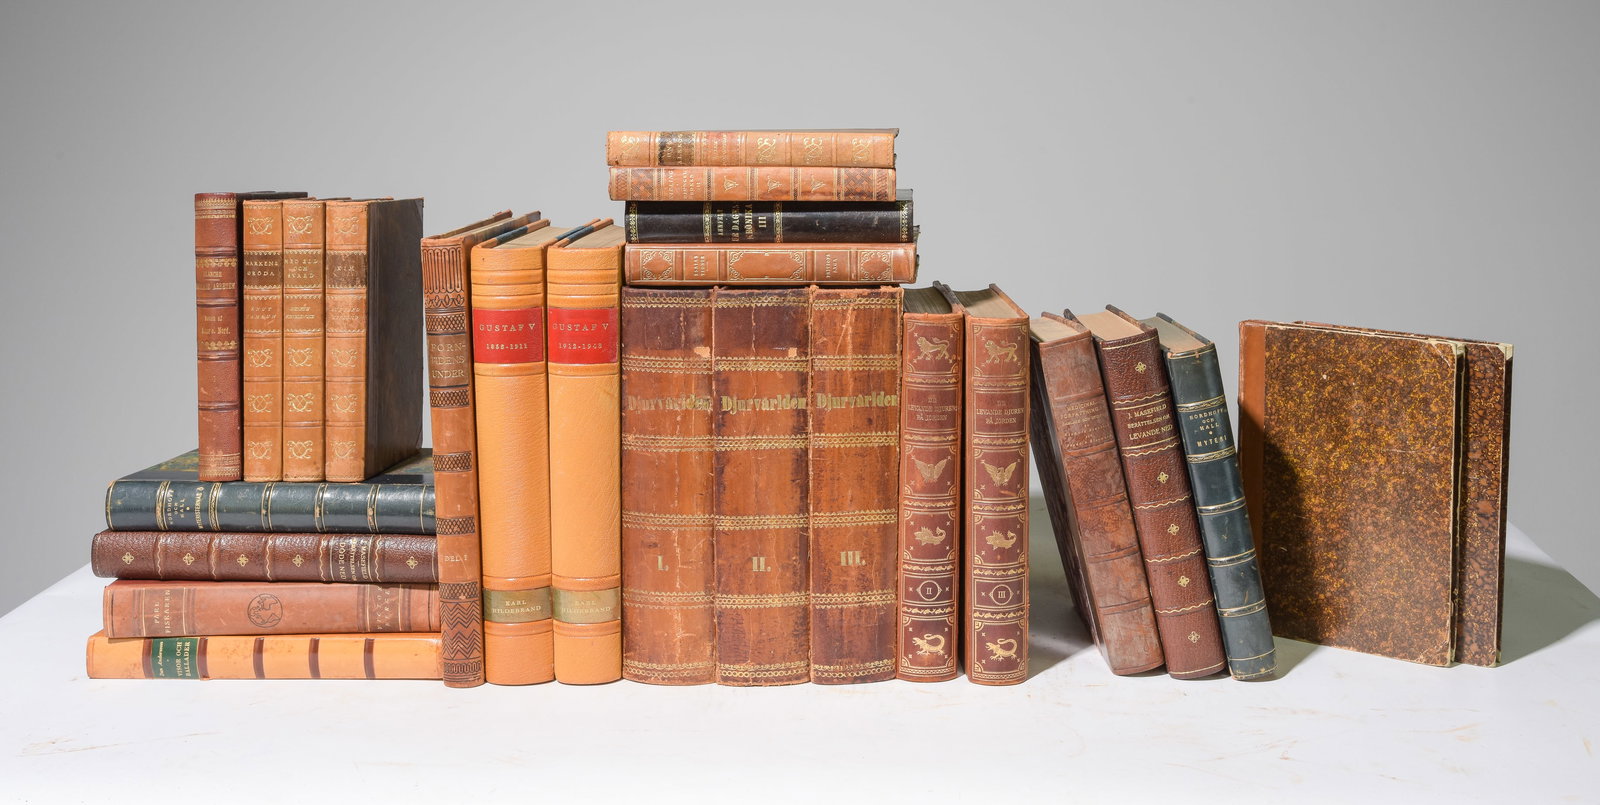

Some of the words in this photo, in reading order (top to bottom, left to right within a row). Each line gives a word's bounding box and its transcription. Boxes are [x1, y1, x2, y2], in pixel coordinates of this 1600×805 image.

[758, 215, 767, 228] III
[479, 322, 524, 332] GUSTAF
[529, 322, 535, 331] V
[552, 323, 598, 332] GUSTAF
[602, 323, 609, 331] V
[431, 368, 465, 379] UNDER
[1134, 403, 1168, 418] MASEFIELD
[1128, 427, 1160, 441] LEVANDE
[1160, 423, 1174, 434] NED
[657, 555, 669, 571] I.
[752, 556, 772, 572] II.
[840, 551, 867, 567] III.
[926, 587, 932, 595] II
[998, 590, 1006, 599] III
[175, 641, 183, 656] OCH
[183, 641, 192, 677] BALLADER
[175, 658, 183, 677] VISOR
